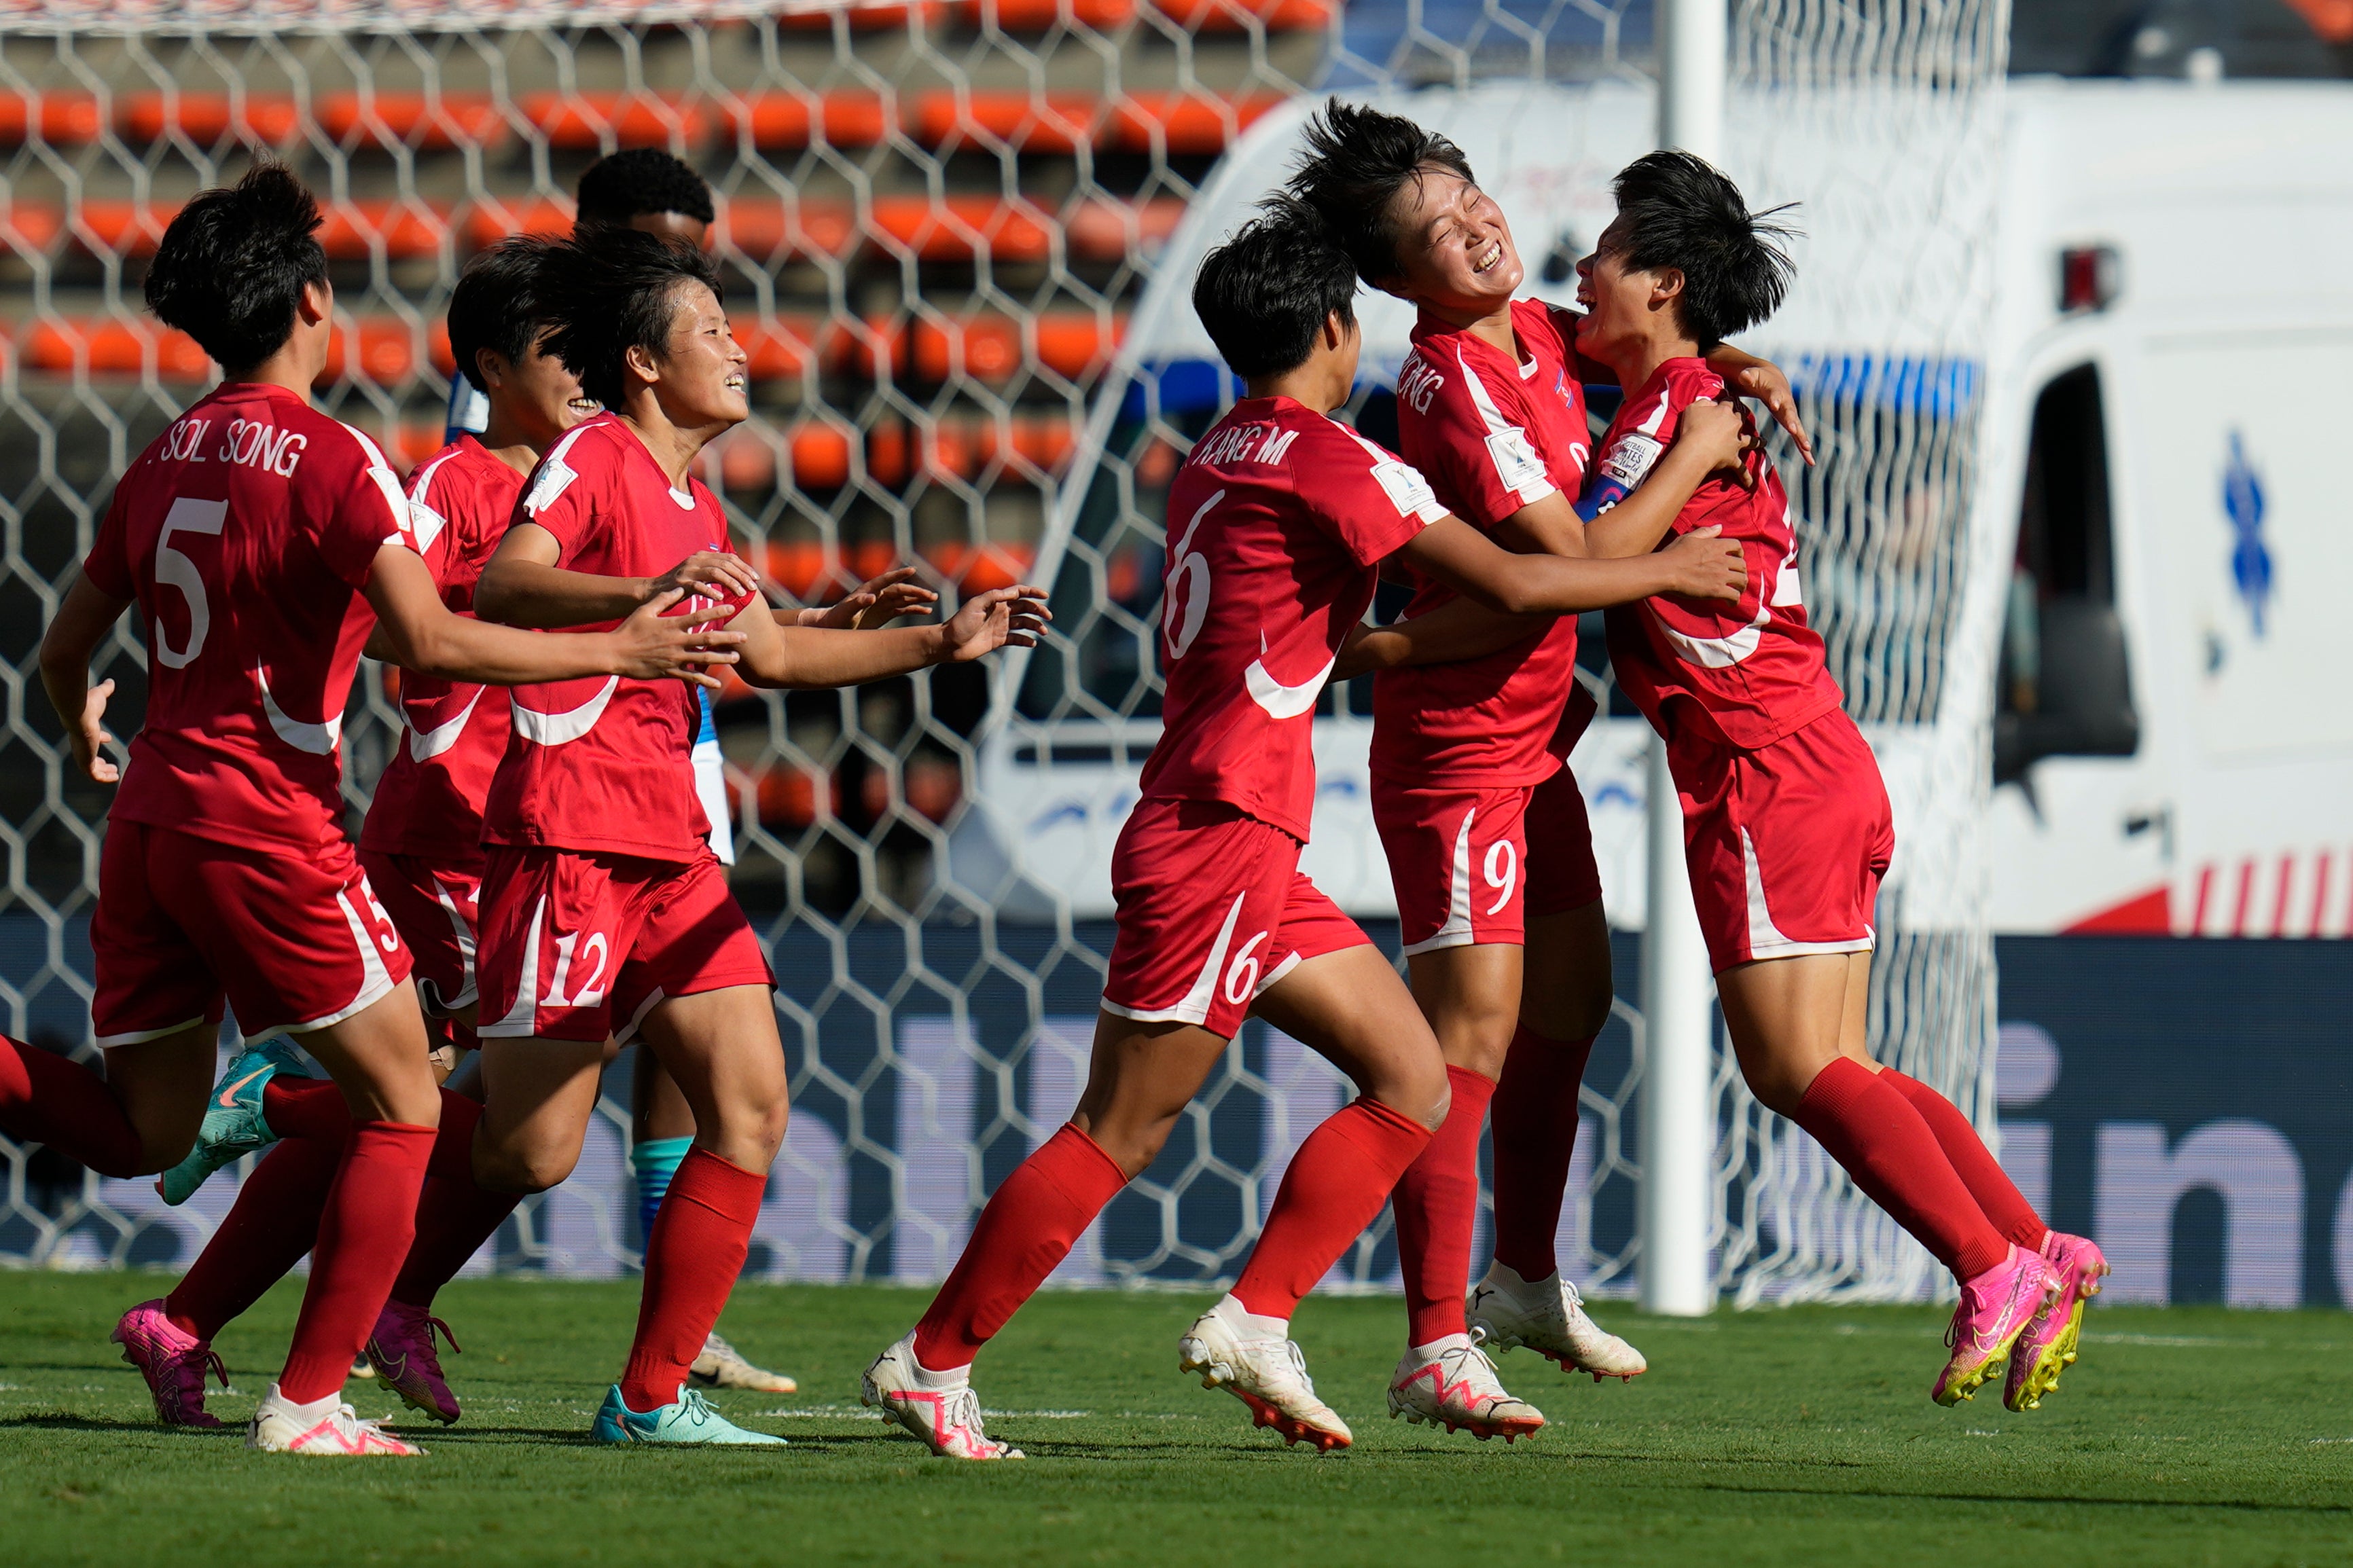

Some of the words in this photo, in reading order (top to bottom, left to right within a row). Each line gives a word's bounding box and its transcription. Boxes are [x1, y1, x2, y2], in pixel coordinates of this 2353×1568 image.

[160, 418, 211, 462] SOL
[218, 418, 308, 478] SONG
[1191, 425, 1262, 466] KANG
[1253, 425, 1300, 466] MI
[155, 496, 230, 670] 5
[1163, 488, 1226, 660] 6
[360, 873, 399, 952] 5
[1483, 839, 1516, 915] 9
[539, 930, 608, 1008] 12
[1225, 930, 1268, 1005] 6
